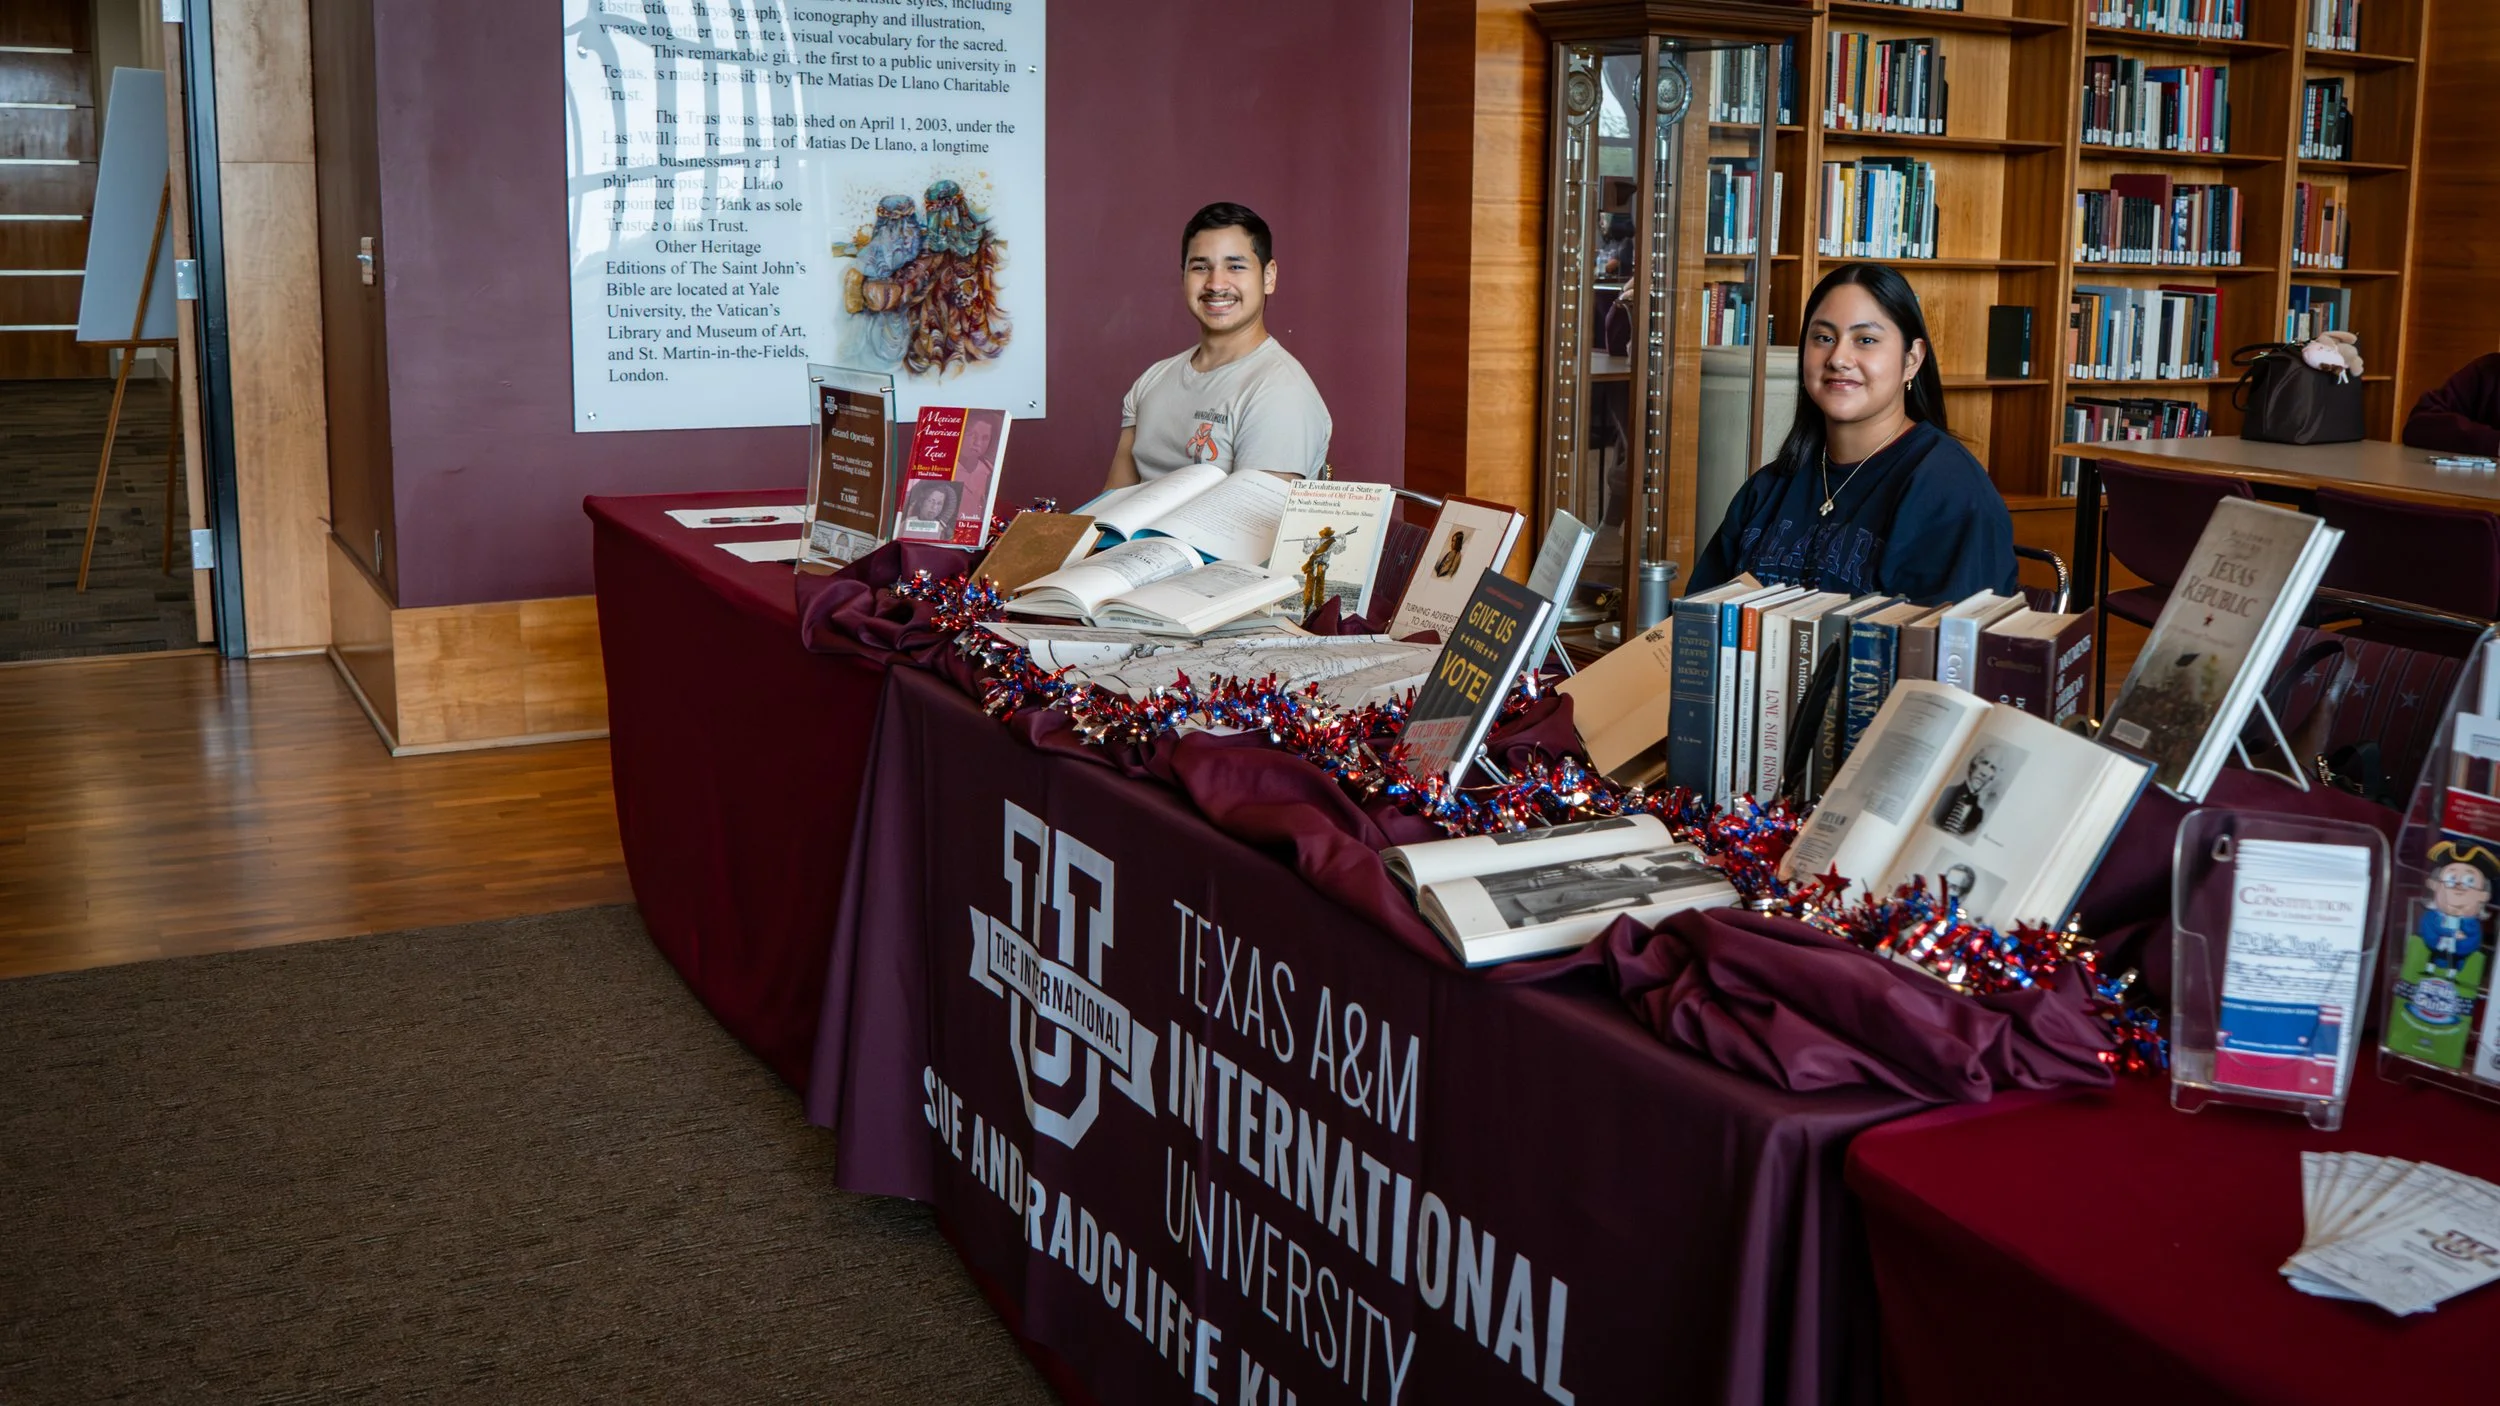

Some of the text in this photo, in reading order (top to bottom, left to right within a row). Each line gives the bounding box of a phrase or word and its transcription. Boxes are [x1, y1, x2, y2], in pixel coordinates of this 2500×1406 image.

[794, 8, 986, 32] iconography and illustration,
[600, 24, 647, 36] weave
[652, 24, 711, 40] together
[734, 28, 776, 41] create
[780, 33, 788, 41] a
[793, 30, 833, 44] visual
[838, 33, 912, 51] vocabulary
[916, 35, 936, 49] for
[939, 37, 959, 51] the
[963, 39, 1008, 53] sacred.
[651, 45, 1017, 75] This remarkable the first to a public university in
[653, 68, 1010, 93] is made possible by The Matias De Llano Charitable
[656, 110, 678, 124] The
[727, 115, 755, 126] was
[839, 117, 856, 129] on
[860, 116, 895, 133] April
[901, 117, 911, 132] 1,
[916, 118, 952, 133] 2003,
[956, 120, 993, 134] under
[996, 120, 1016, 134] the
[602, 130, 633, 145] Last
[674, 132, 700, 146] and
[705, 132, 777, 148] Testament
[781, 135, 798, 148] of
[802, 136, 846, 150] Matias
[850, 137, 870, 150] De
[875, 138, 916, 153] Llano,
[921, 143, 928, 152] a
[933, 139, 989, 156] longtime
[659, 154, 780, 169] businessman and
[743, 176, 783, 190] Llano
[715, 197, 751, 211] Bank
[756, 201, 771, 211] as
[775, 198, 803, 212] sole
[663, 218, 679, 232] of
[708, 218, 749, 233] Trust.
[656, 239, 762, 257] Other Heritage
[606, 260, 806, 275] Editions of The Saint John's
[607, 282, 780, 296] Bible are located at Yale
[607, 303, 780, 321] University, the Vatican's
[608, 324, 806, 342] Library and Museum of Art,
[608, 345, 809, 361] and St. Martin-in-the-Fields,
[609, 368, 669, 383] London.
[923, 411, 961, 426] Mexican
[832, 427, 875, 447] Grand Opening
[917, 424, 960, 438] Americans
[831, 452, 845, 462] Texas
[924, 445, 947, 461] Texas
[1290, 488, 1327, 498] Recollections
[1334, 491, 1346, 499] Old
[1365, 494, 1380, 502] Days
[1293, 480, 1307, 490] The
[1308, 481, 1341, 491] Evolution
[1342, 483, 1350, 491] of
[1356, 484, 1374, 493] State
[1298, 498, 1312, 506] Noah
[1313, 498, 1342, 508] Smithwick
[2207, 553, 2259, 588] TEXAS
[2181, 575, 2260, 618] REPUBLIC
[1405, 602, 1432, 617] TURNING
[1411, 615, 1422, 625] TO
[1468, 600, 1518, 645] GIVE US
[1472, 639, 1485, 655] THE
[1798, 629, 1812, 655] José
[1439, 649, 1493, 704] VOTE!
[1848, 656, 1881, 721] LONE
[1761, 689, 1780, 793] LONE STAR RISING
[2238, 886, 2354, 913] CONSTITUTION
[996, 931, 1122, 1055] THE INTERNATIONAL
[1172, 898, 1420, 1142] TEXAS A&M
[1168, 1020, 1576, 1406] INTERNATIONAL
[923, 1065, 964, 1162] SUE
[971, 1113, 1025, 1216] AND
[1024, 1171, 1222, 1405] RADCLIFFE
[1166, 1146, 1417, 1406] UNIVERSITY
